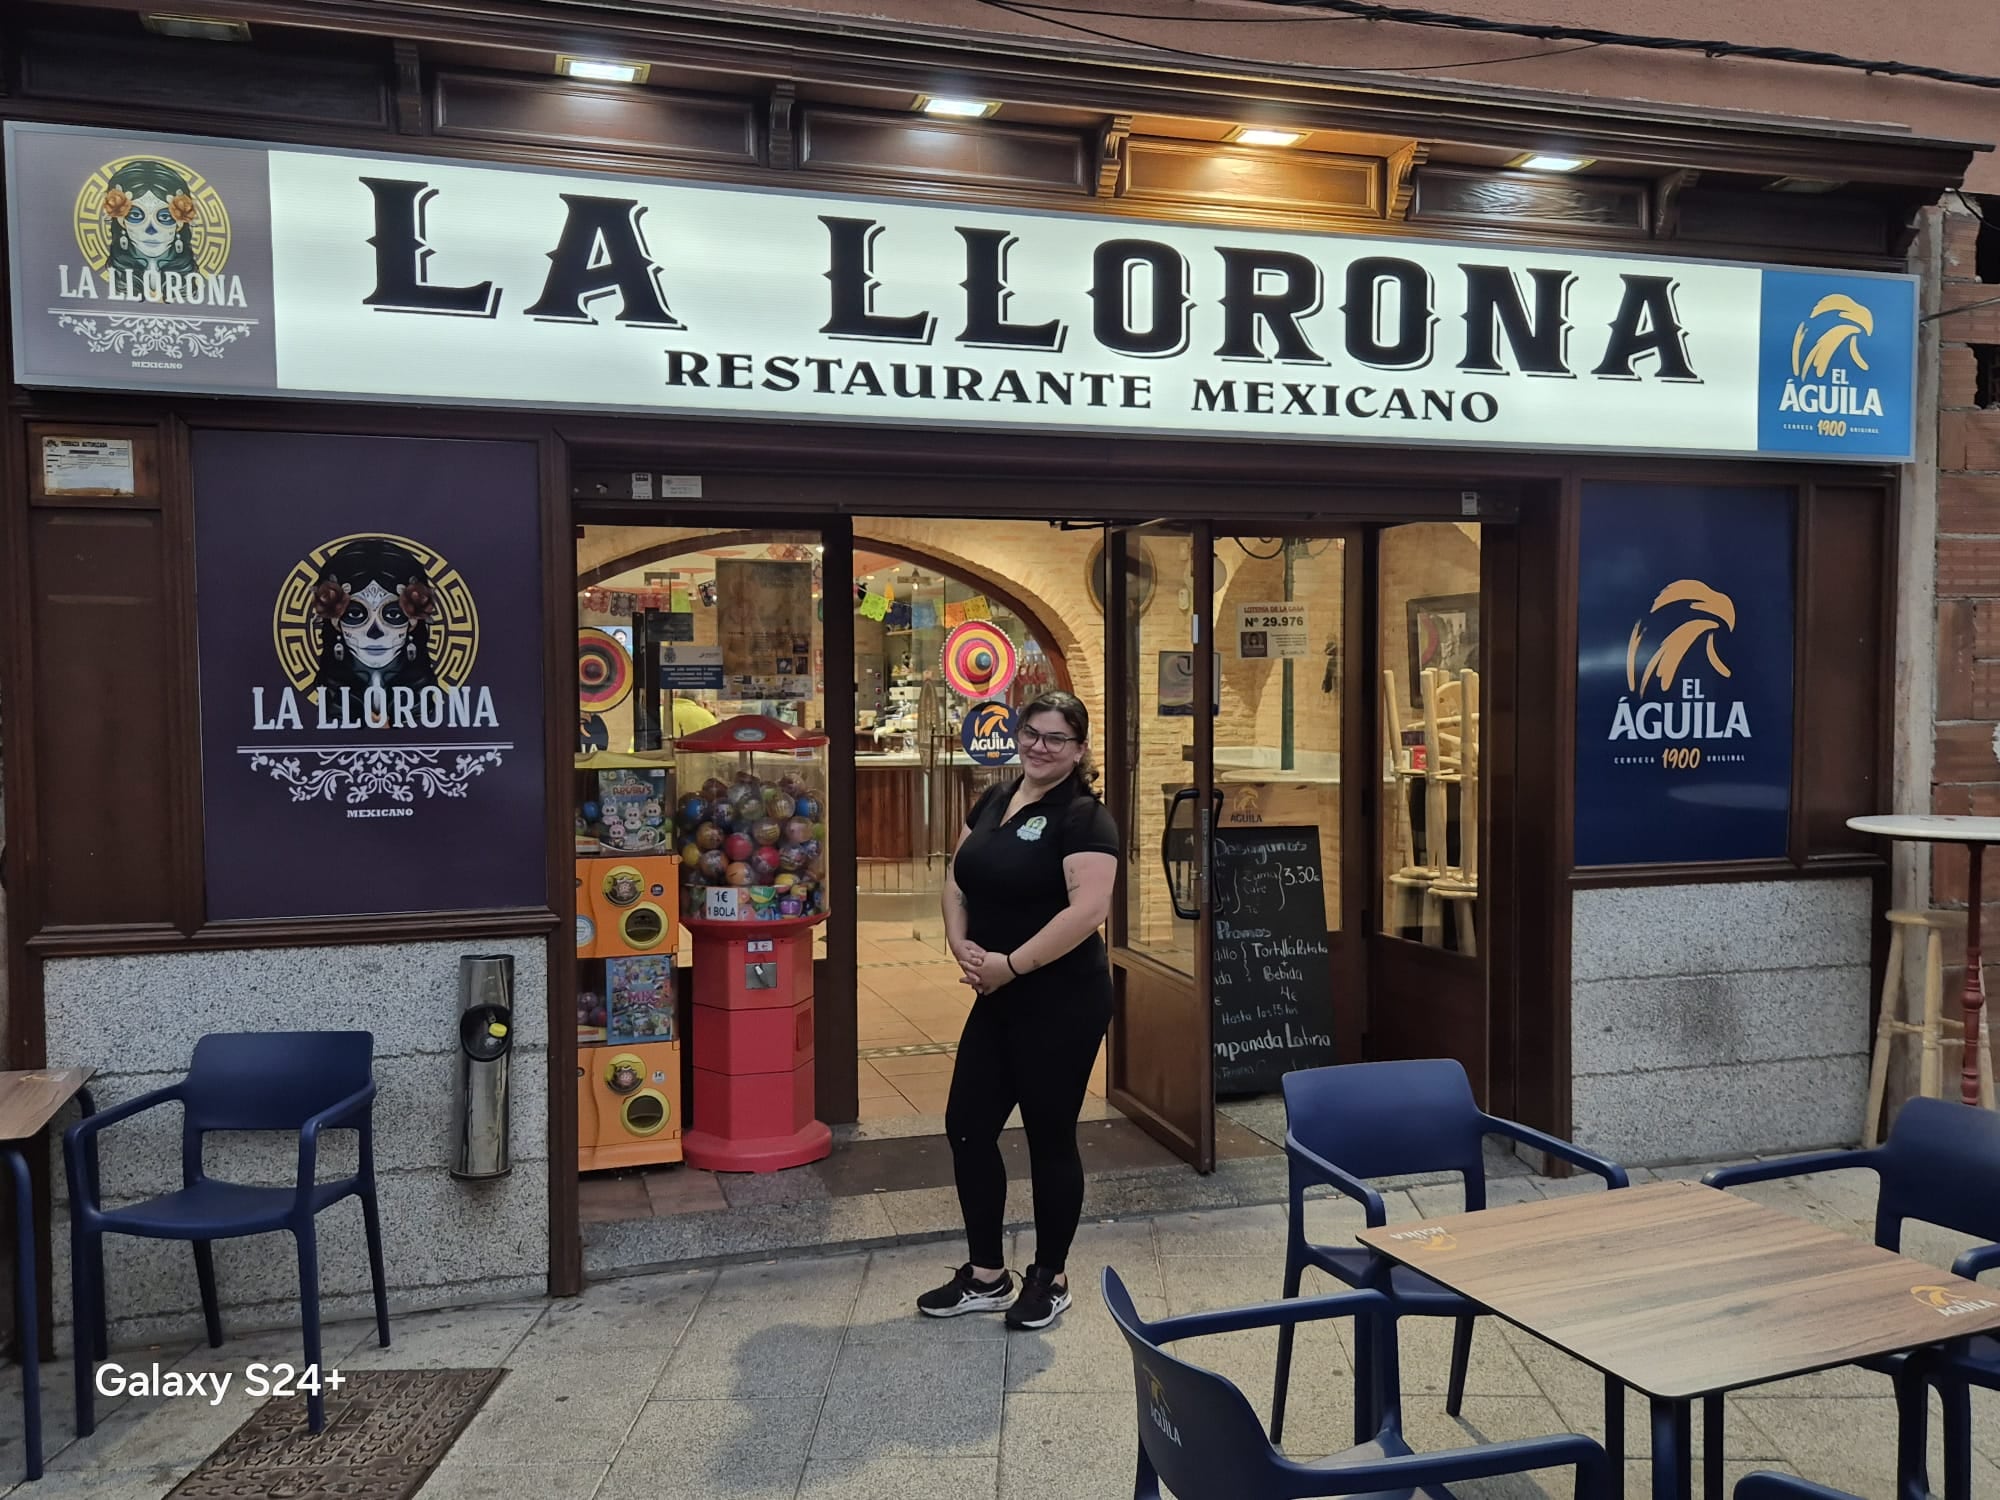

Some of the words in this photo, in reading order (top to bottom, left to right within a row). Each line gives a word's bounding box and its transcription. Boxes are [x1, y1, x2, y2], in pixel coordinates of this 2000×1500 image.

[58, 264, 99, 300] LA
[107, 267, 248, 308] LLORONA
[359, 177, 688, 331] LA
[818, 215, 1704, 384] LLORONA
[131, 360, 183, 370] MEXICANO
[1831, 368, 1849, 385] EL
[664, 350, 1152, 409] RESTAURANTE
[1191, 378, 1499, 424] MEXICANO
[1779, 378, 1884, 417] ÁGUILA
[1817, 419, 1847, 437] 1900
[1262, 615, 1304, 627] 29.976
[1682, 678, 1705, 699] EL
[252, 686, 304, 730] LA
[316, 685, 500, 729] LLORONA
[1608, 696, 1752, 740] ÁGUILA
[1662, 747, 1701, 769] 1900
[346, 808, 414, 818] MEXICANO
[715, 891, 728, 903] 1€
[713, 906, 736, 917] BOLA
[1251, 938, 1296, 958] Tortilla
[1263, 965, 1303, 982] Bebida
[1222, 1009, 1252, 1025] Hasta
[1214, 1028, 1283, 1062] mpanada
[1285, 1022, 1331, 1048] Latina
